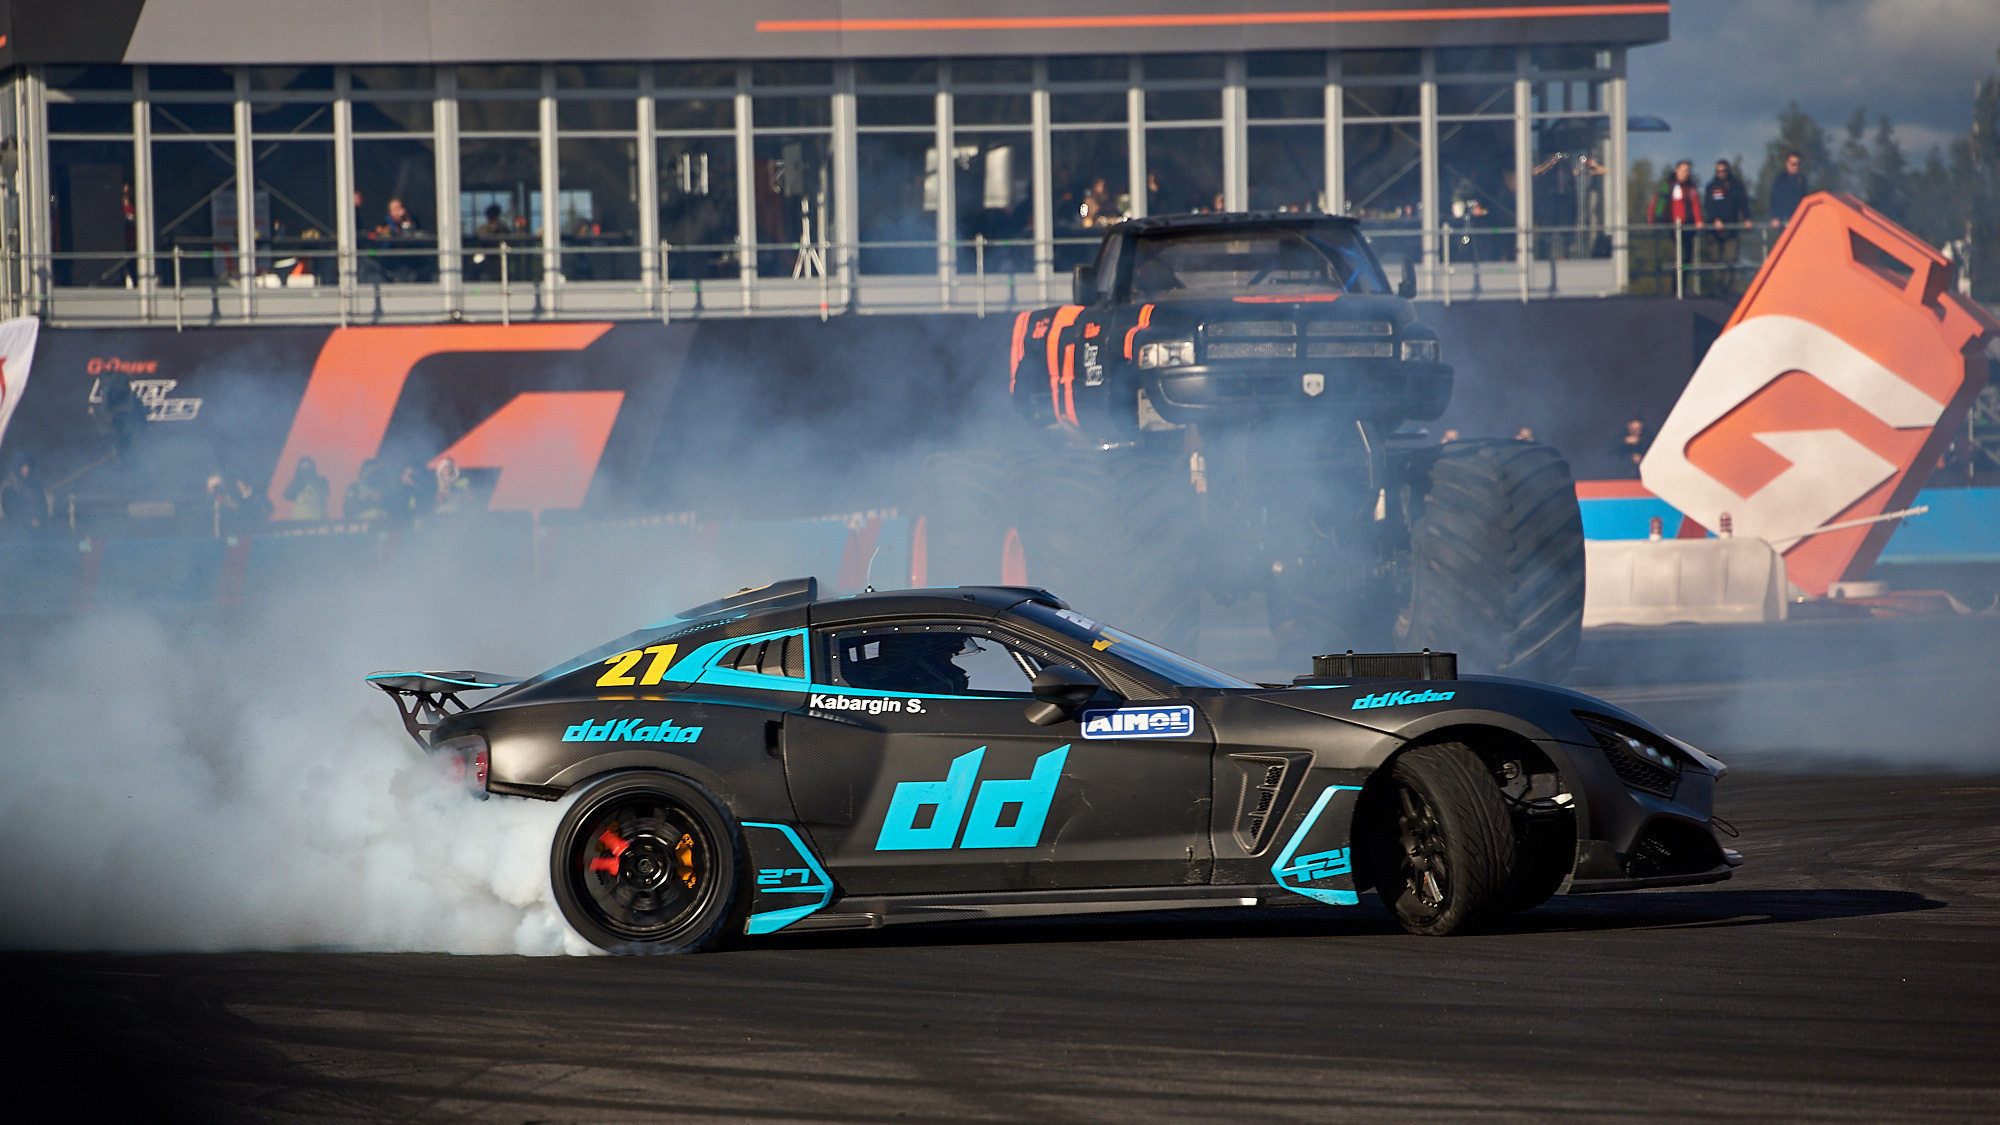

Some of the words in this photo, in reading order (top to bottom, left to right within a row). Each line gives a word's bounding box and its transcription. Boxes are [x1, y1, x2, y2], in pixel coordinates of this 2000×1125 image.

[595, 643, 679, 687] 27
[809, 693, 902, 715] Kabargin
[906, 698, 927, 714] S.
[1351, 688, 1457, 710] ddKaba
[561, 718, 704, 744] ddKaba
[1086, 711, 1189, 733] AIMOL
[875, 743, 1072, 851] dd
[756, 868, 810, 885] 27
